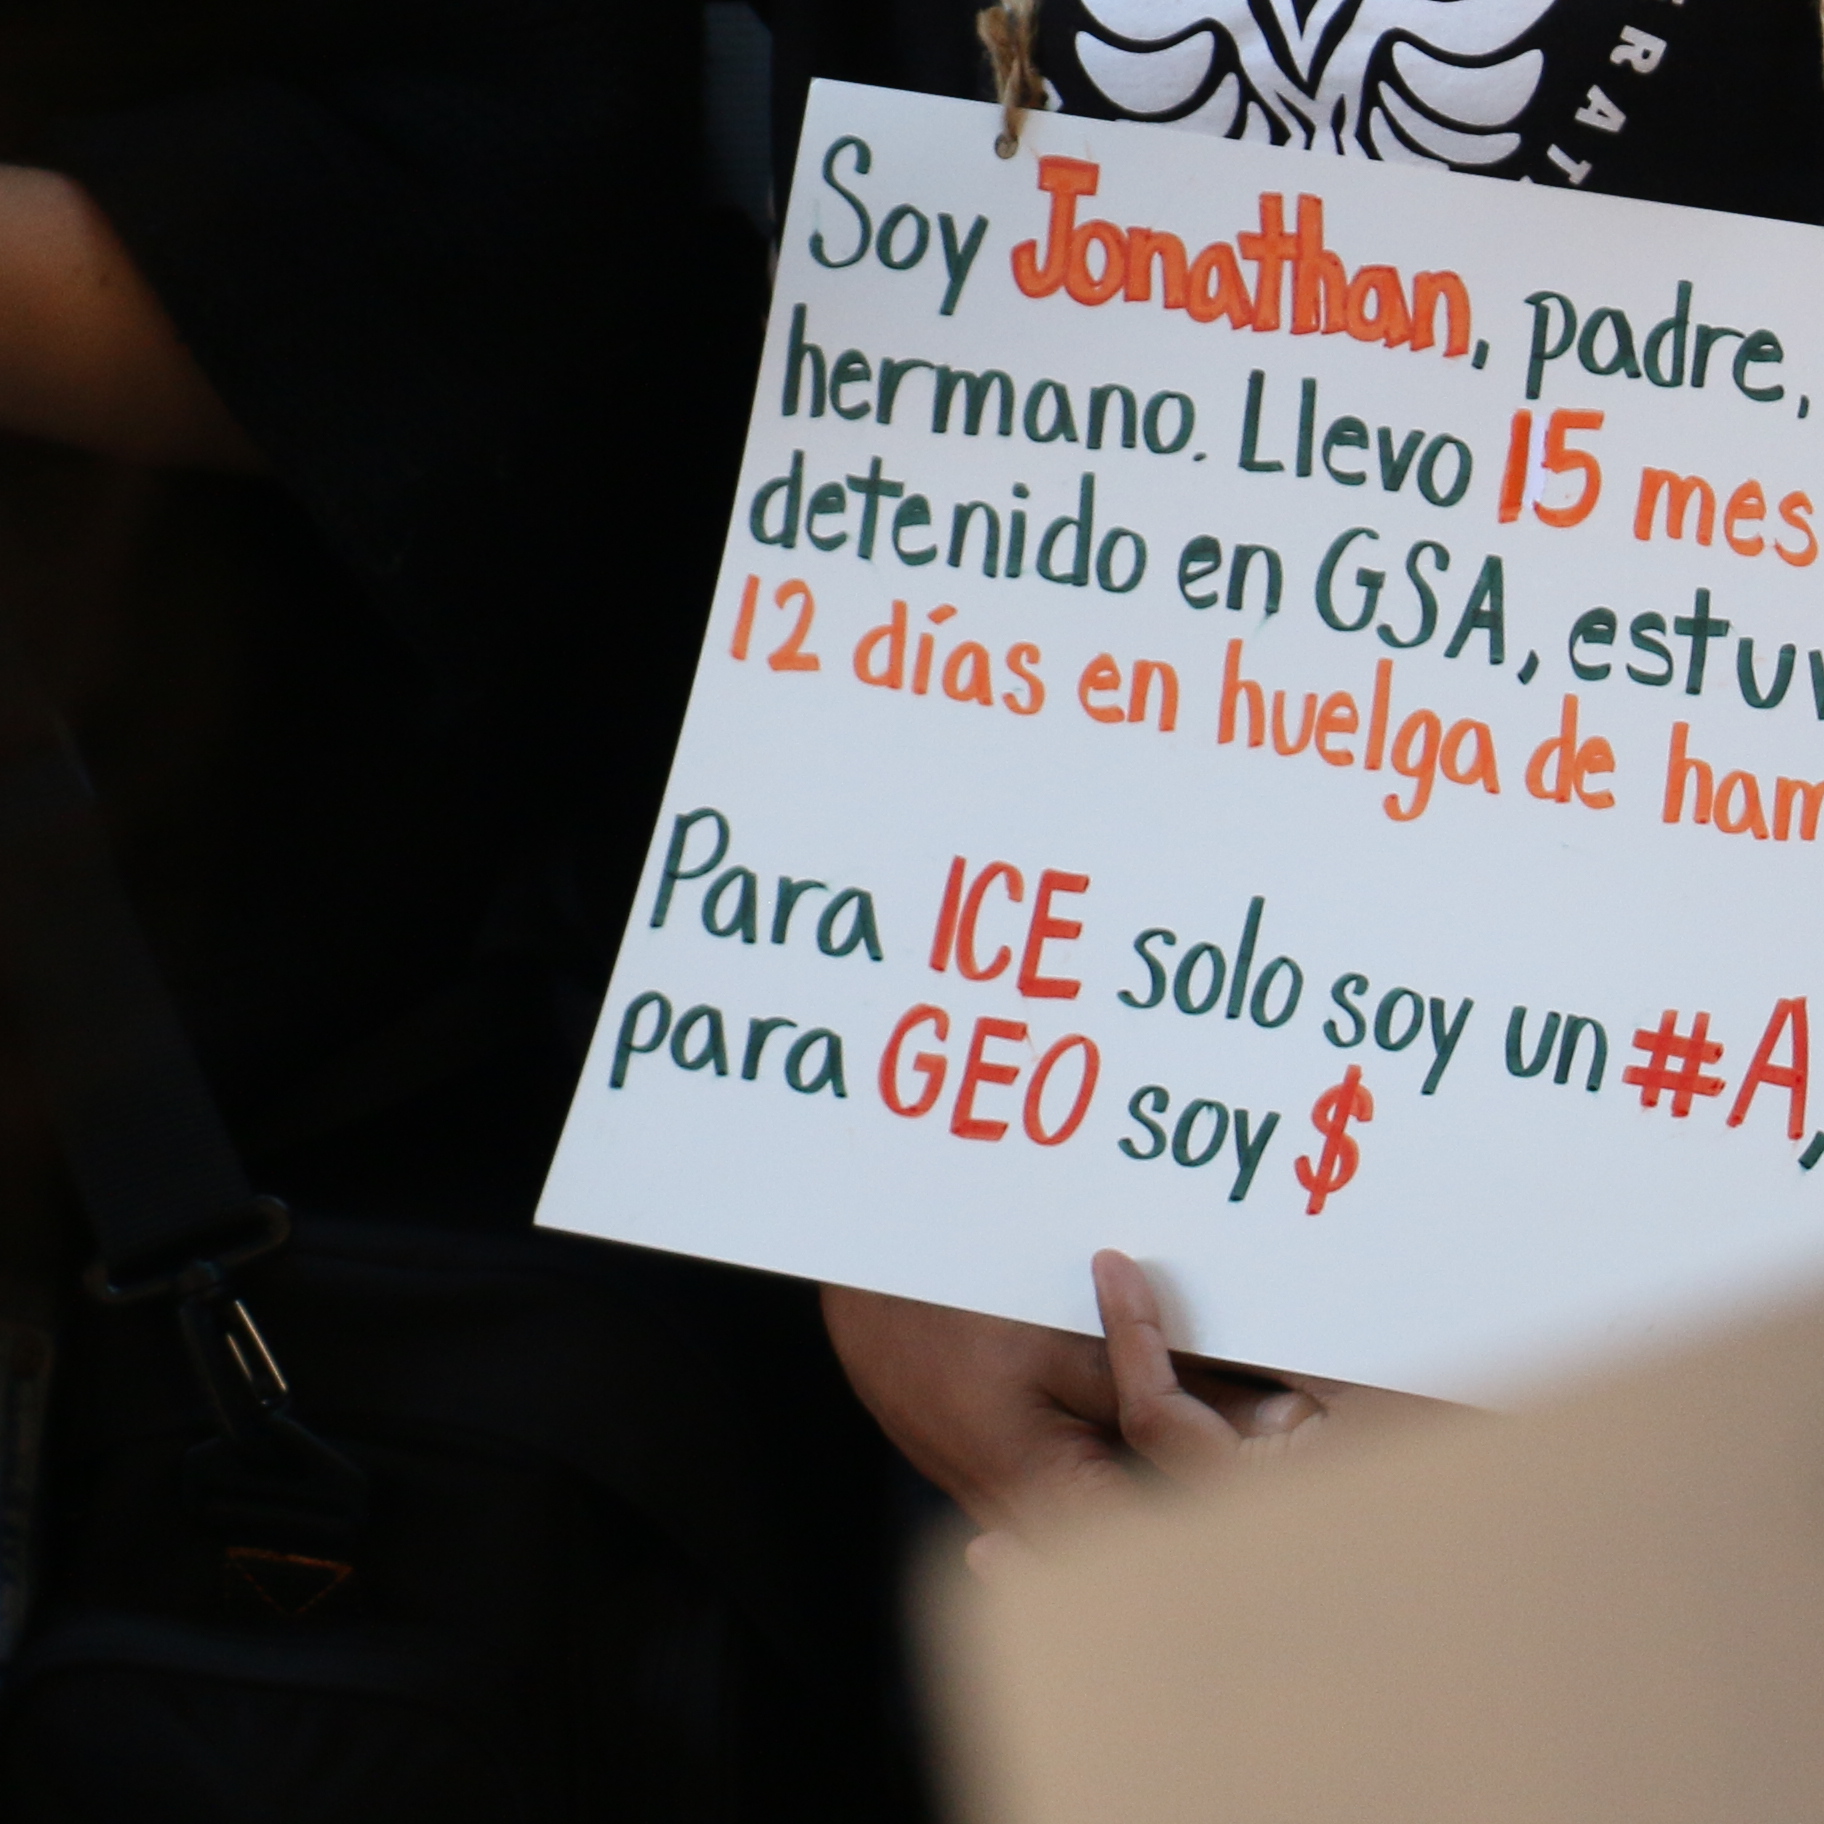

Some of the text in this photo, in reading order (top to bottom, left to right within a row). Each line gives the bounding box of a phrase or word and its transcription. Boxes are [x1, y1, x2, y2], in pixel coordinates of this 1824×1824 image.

[808, 136, 989, 317] Soy
[1010, 155, 1490, 370] Jonathan,
[1524, 280, 1809, 419] padre,
[781, 303, 1206, 462] hermano.
[1238, 369, 1473, 508] Llevo
[1498, 408, 1605, 528] 15
[749, 449, 1147, 594] detenido
[1177, 535, 1283, 620] en
[1315, 528, 1539, 685] GSA,
[731, 575, 820, 671] 12
[853, 600, 1045, 715] días
[1078, 654, 1179, 732] en
[1218, 639, 1500, 821] huelga
[1525, 694, 1616, 809] de
[649, 808, 884, 963] Para
[929, 856, 1090, 1000] ICE
[1117, 896, 1303, 1029] solo
[1323, 973, 1474, 1096] soy
[1505, 1006, 1608, 1094] un
[608, 991, 1374, 1216] para GEO soy $
